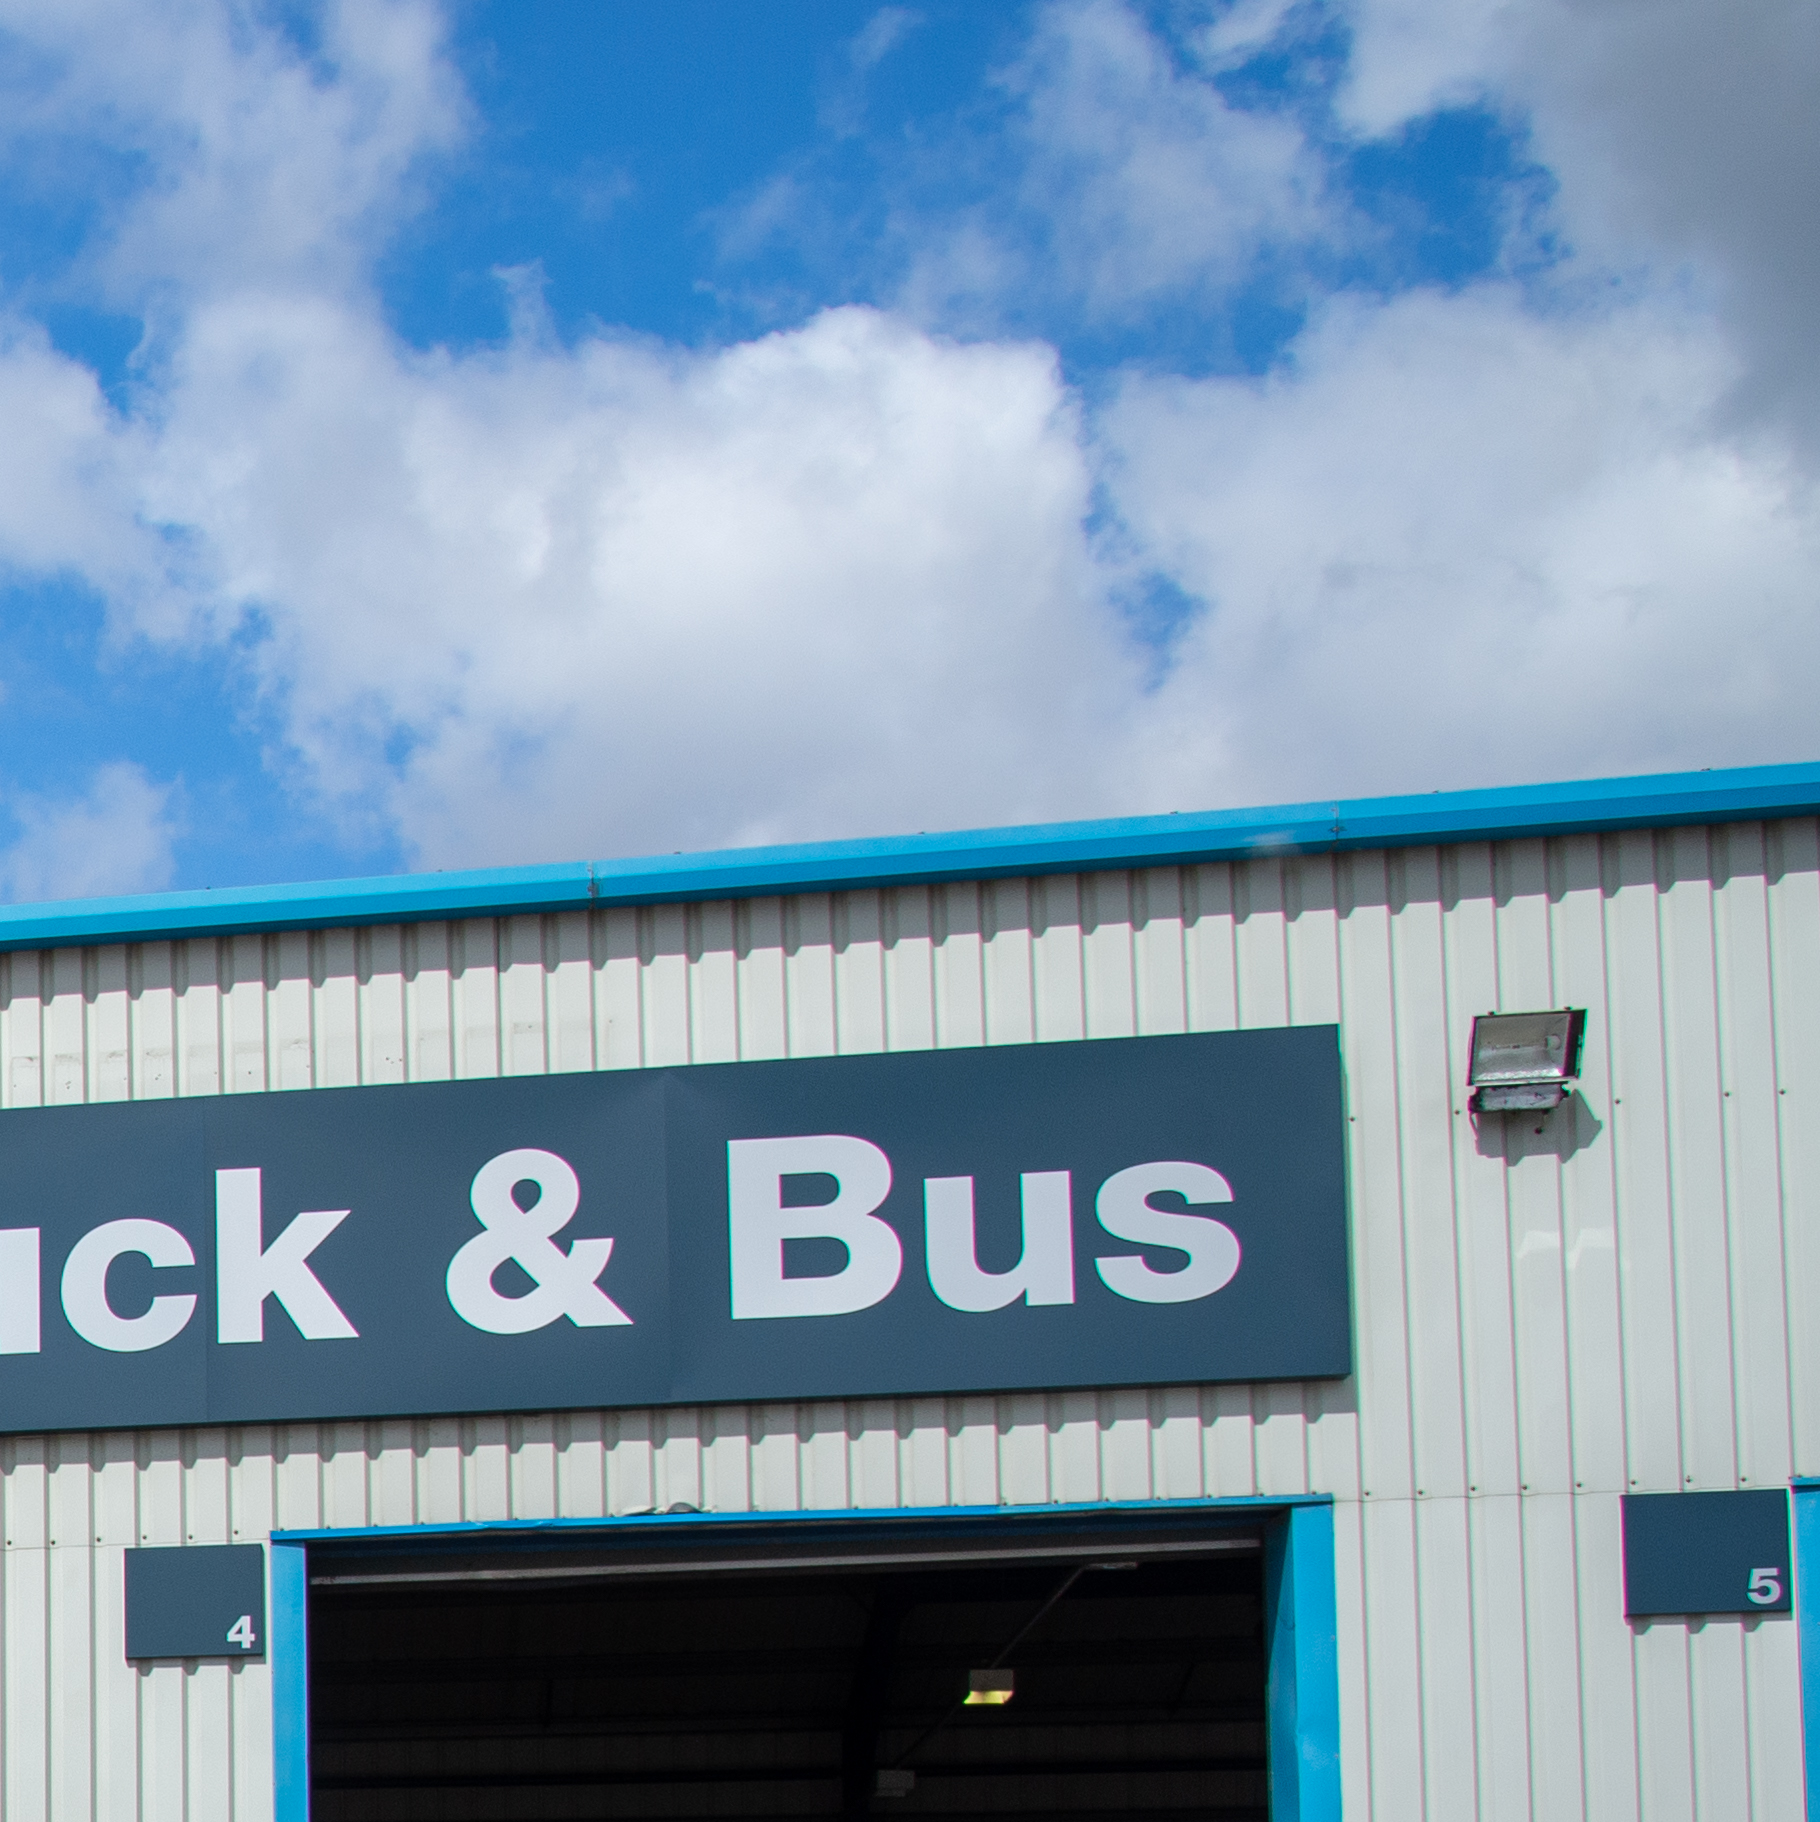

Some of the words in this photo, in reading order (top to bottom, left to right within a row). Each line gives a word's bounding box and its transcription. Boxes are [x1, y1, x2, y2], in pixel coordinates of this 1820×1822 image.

[445, 1148, 634, 1335] &
[726, 1134, 1240, 1320] Bus
[1746, 1567, 1782, 1605] 5
[226, 1615, 256, 1649] 4
